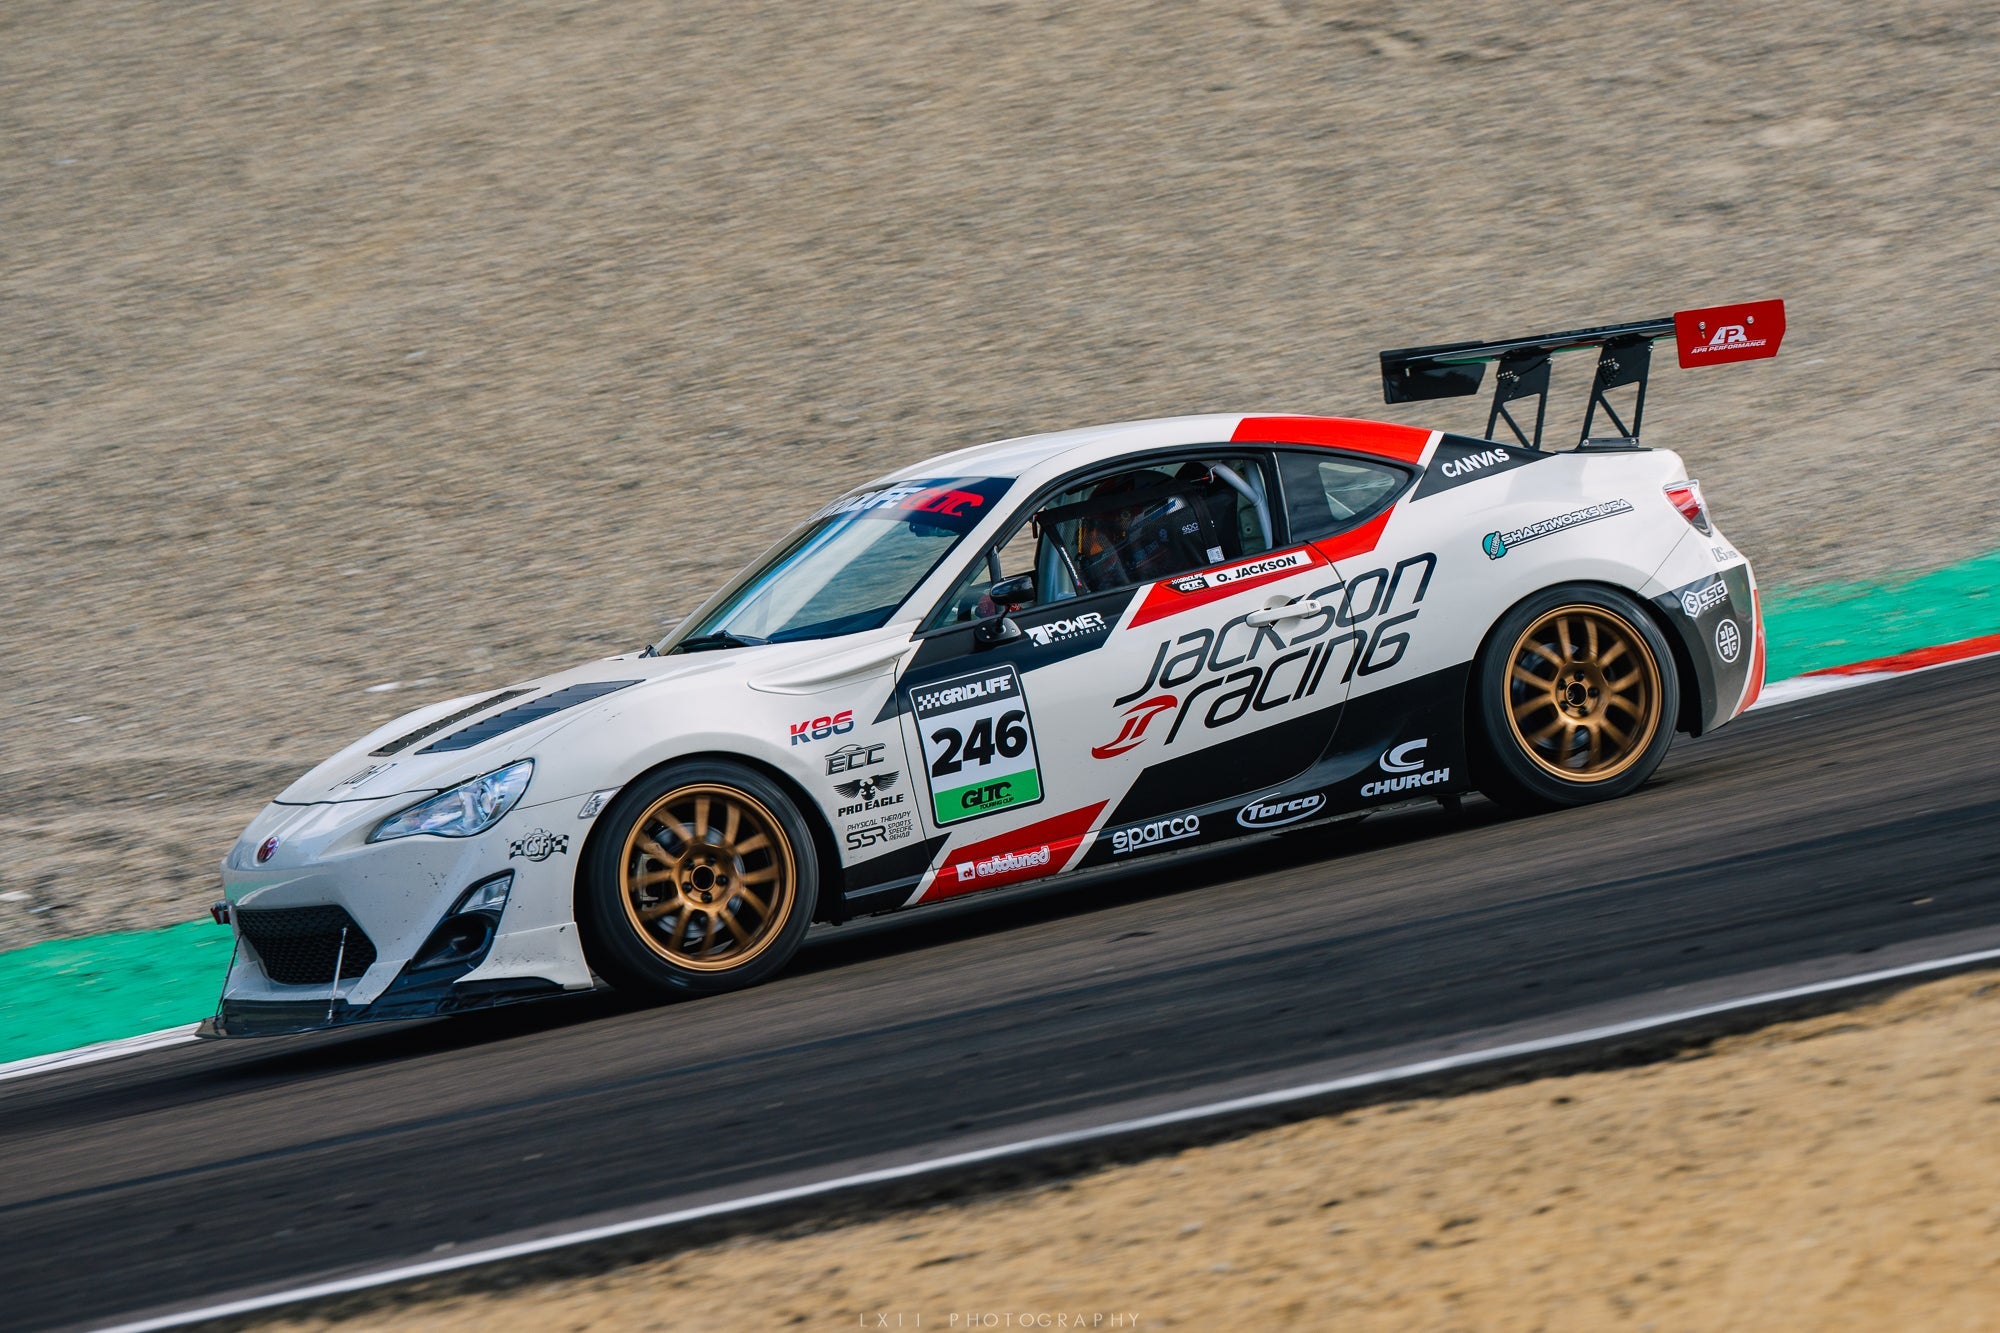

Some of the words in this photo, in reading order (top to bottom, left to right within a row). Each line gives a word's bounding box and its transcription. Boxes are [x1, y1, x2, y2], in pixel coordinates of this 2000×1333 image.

[1691, 346, 1707, 354] APR
[1708, 339, 1767, 352] PERFORMANCE
[1441, 448, 1510, 478] CANVAS
[1501, 504, 1600, 545] SHAFTWORKS
[1600, 499, 1633, 516] USA
[1216, 573, 1232, 583] O.
[1235, 556, 1297, 579] JACKSON
[1179, 579, 1204, 591] GLTC
[1699, 583, 1725, 605] CSG
[1042, 612, 1105, 638] POWER
[1049, 624, 1107, 643] INDUSTRIES
[939, 674, 1012, 706] GRIDLIFE
[790, 709, 854, 746] K86
[931, 709, 1028, 778] 246
[825, 743, 886, 776] ECC
[961, 782, 1012, 809] GLTC
[1360, 768, 1450, 797] CHURCH
[837, 803, 863, 818] PRO
[865, 793, 904, 811] EAGLE
[979, 799, 1002, 809] TOURING
[1249, 795, 1320, 821] Torco
[847, 819, 878, 831] PHYSICAL
[880, 811, 911, 823] THERAPY
[887, 819, 912, 830] SPORTS
[888, 825, 913, 836] SPECIFIC
[1112, 815, 1200, 852] sparco
[525, 836, 548, 855] CSF
[846, 825, 888, 851] SSR
[888, 831, 910, 840] REHAB
[976, 846, 1050, 877] autotuned
